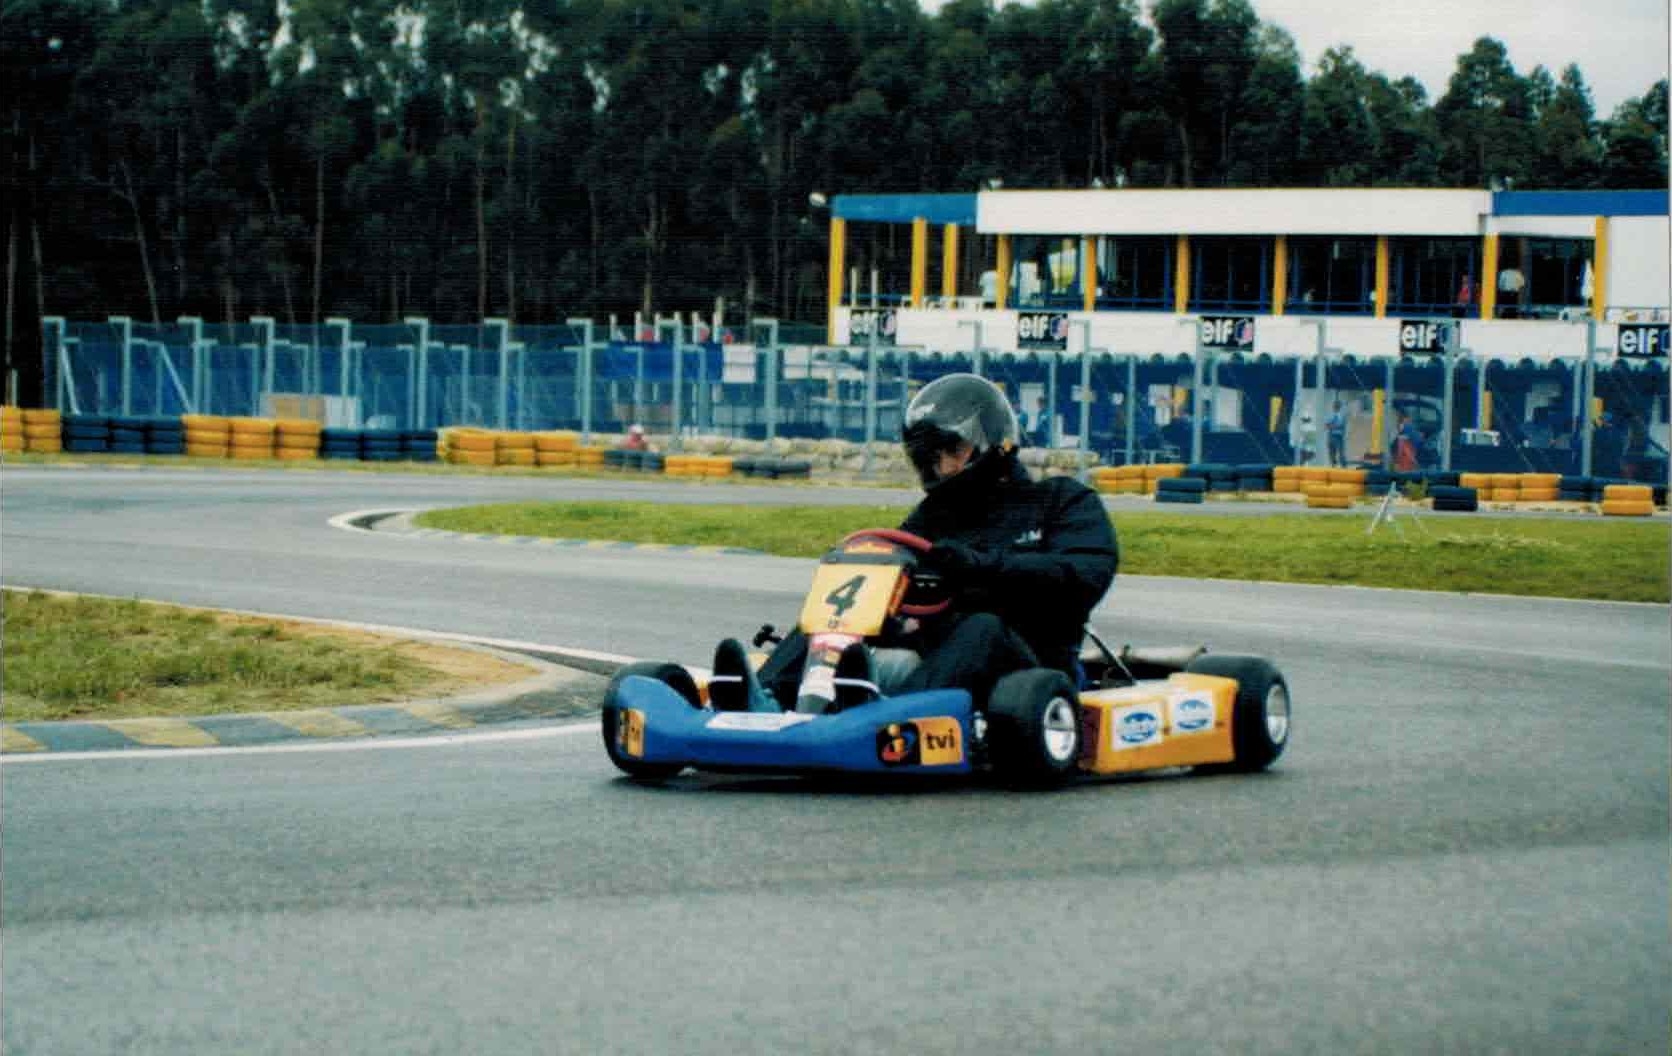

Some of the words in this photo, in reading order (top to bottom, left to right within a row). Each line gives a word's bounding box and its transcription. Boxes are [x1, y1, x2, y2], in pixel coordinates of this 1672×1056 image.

[1019, 315, 1049, 339] elf
[1203, 319, 1233, 345] elf
[1402, 324, 1436, 349] elf
[1620, 328, 1658, 354] elf
[826, 575, 867, 617] 4
[925, 728, 955, 750] tvi
